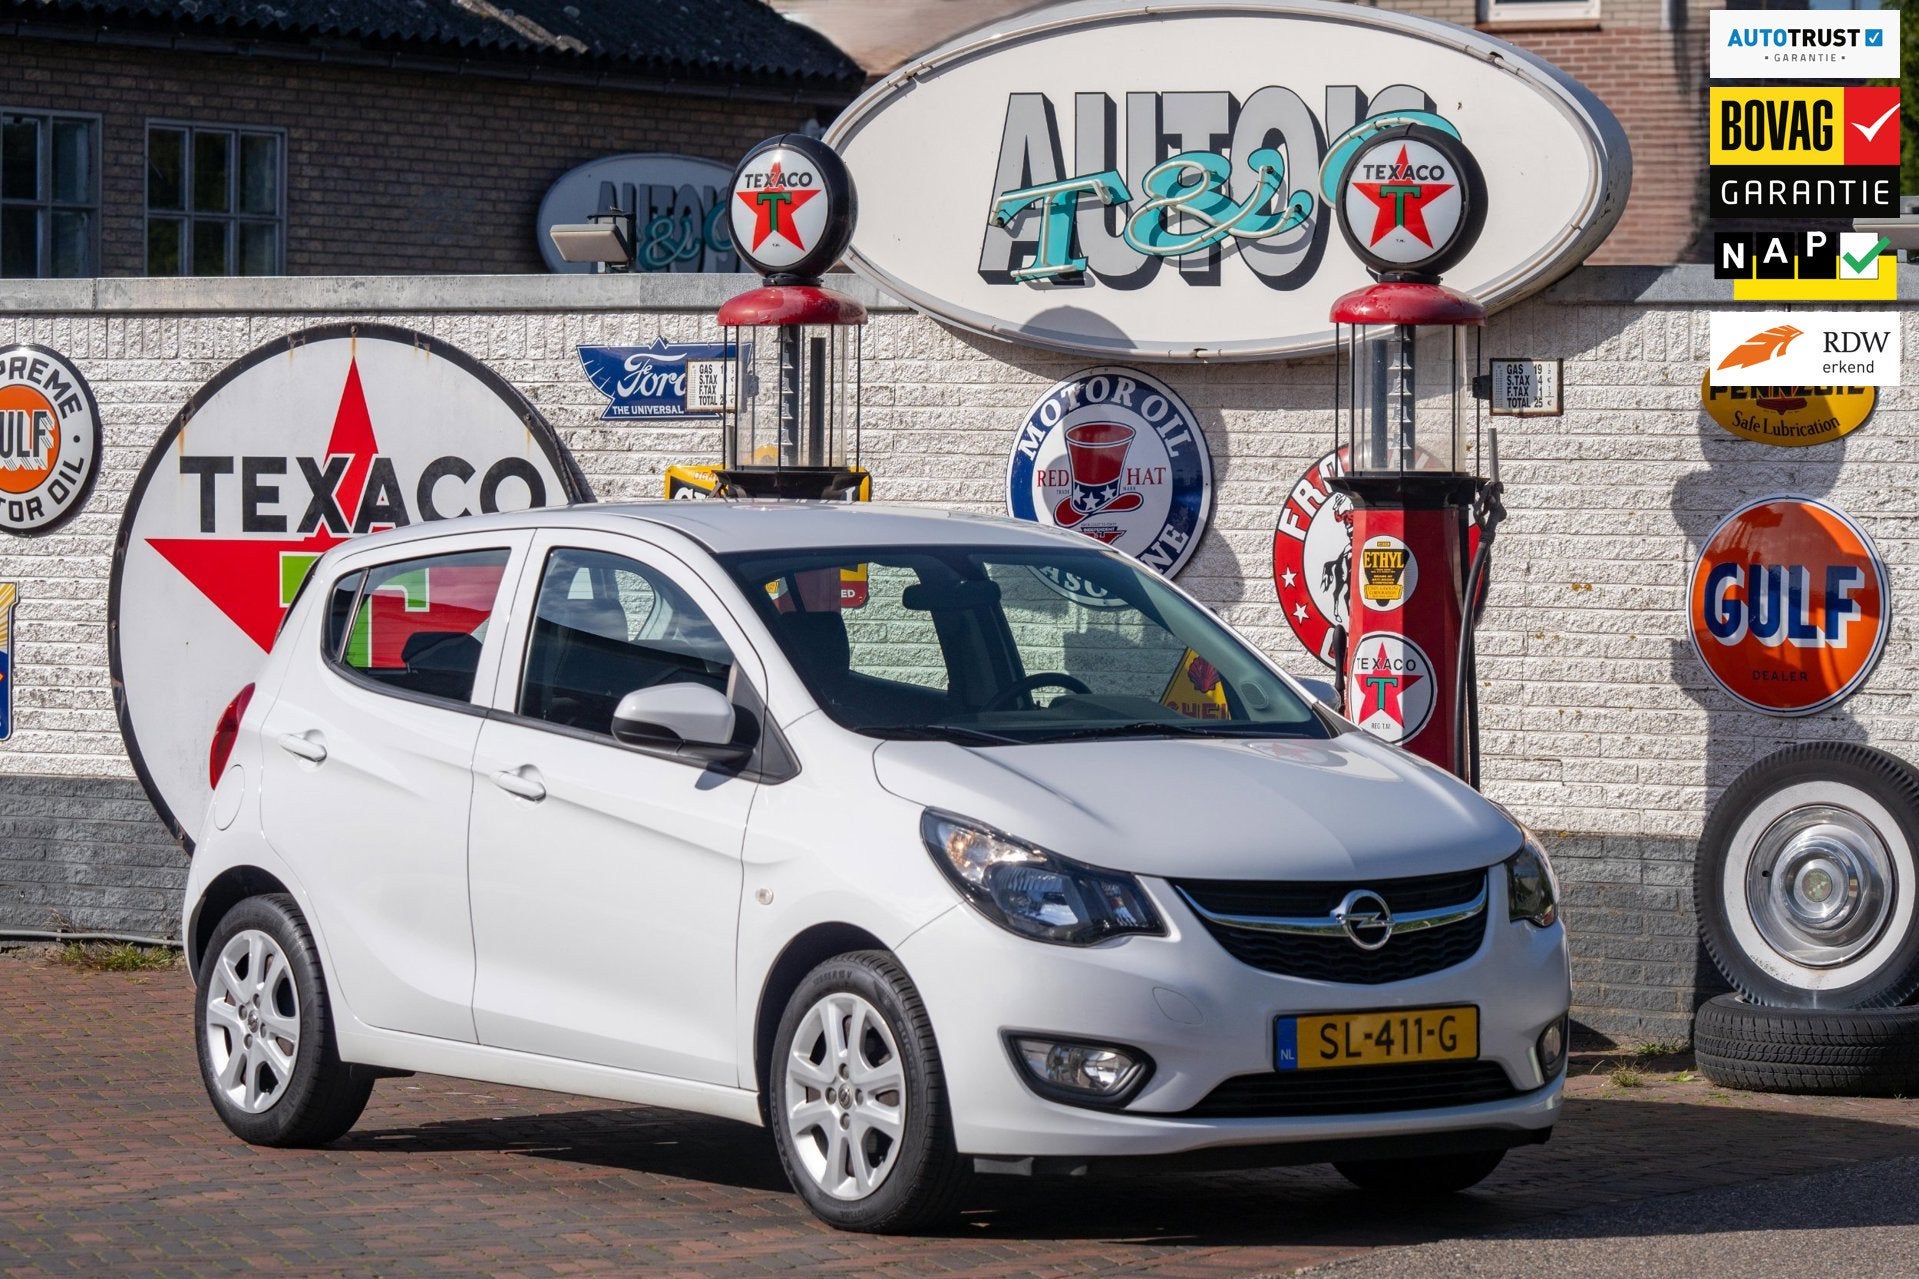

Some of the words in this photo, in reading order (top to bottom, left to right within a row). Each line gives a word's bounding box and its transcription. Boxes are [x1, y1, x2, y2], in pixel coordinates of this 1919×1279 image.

[744, 171, 813, 189] TEXACO
[1363, 164, 1445, 181] TEXACO
[756, 191, 792, 233] T
[1379, 184, 1422, 228] T
[699, 364, 713, 374] GAS
[1506, 364, 1524, 375] GAS
[1533, 364, 1543, 375] 19
[699, 375, 718, 385] S.TAX
[1506, 375, 1530, 386] S.TAX
[1537, 375, 1543, 386] 4
[699, 385, 717, 395] F.TAX
[1506, 386, 1529, 397] F.TAX
[699, 396, 718, 406] TOTAL
[1506, 397, 1531, 408] TOTAL
[1533, 397, 1543, 408] 25
[612, 406, 630, 415] THE
[631, 406, 684, 415] UNIVERSAL
[1018, 375, 1137, 462] MOTOR
[1141, 394, 1192, 458] OIL
[1732, 410, 1761, 433] Safe
[1763, 416, 1841, 437] Lubrication
[0, 410, 52, 463] ULF
[47, 456, 84, 505] OIL
[1037, 469, 1069, 488] RED
[1126, 467, 1167, 486] HAT
[179, 455, 547, 533] TEXACO
[1363, 551, 1405, 569] ETHYL
[1704, 562, 1865, 649] GULF
[1356, 657, 1417, 671] TEXACO
[1752, 669, 1809, 682] DEALER
[1366, 677, 1399, 711] T
[1320, 1015, 1457, 1059] SL-411-G
[1280, 1049, 1295, 1060] NL
